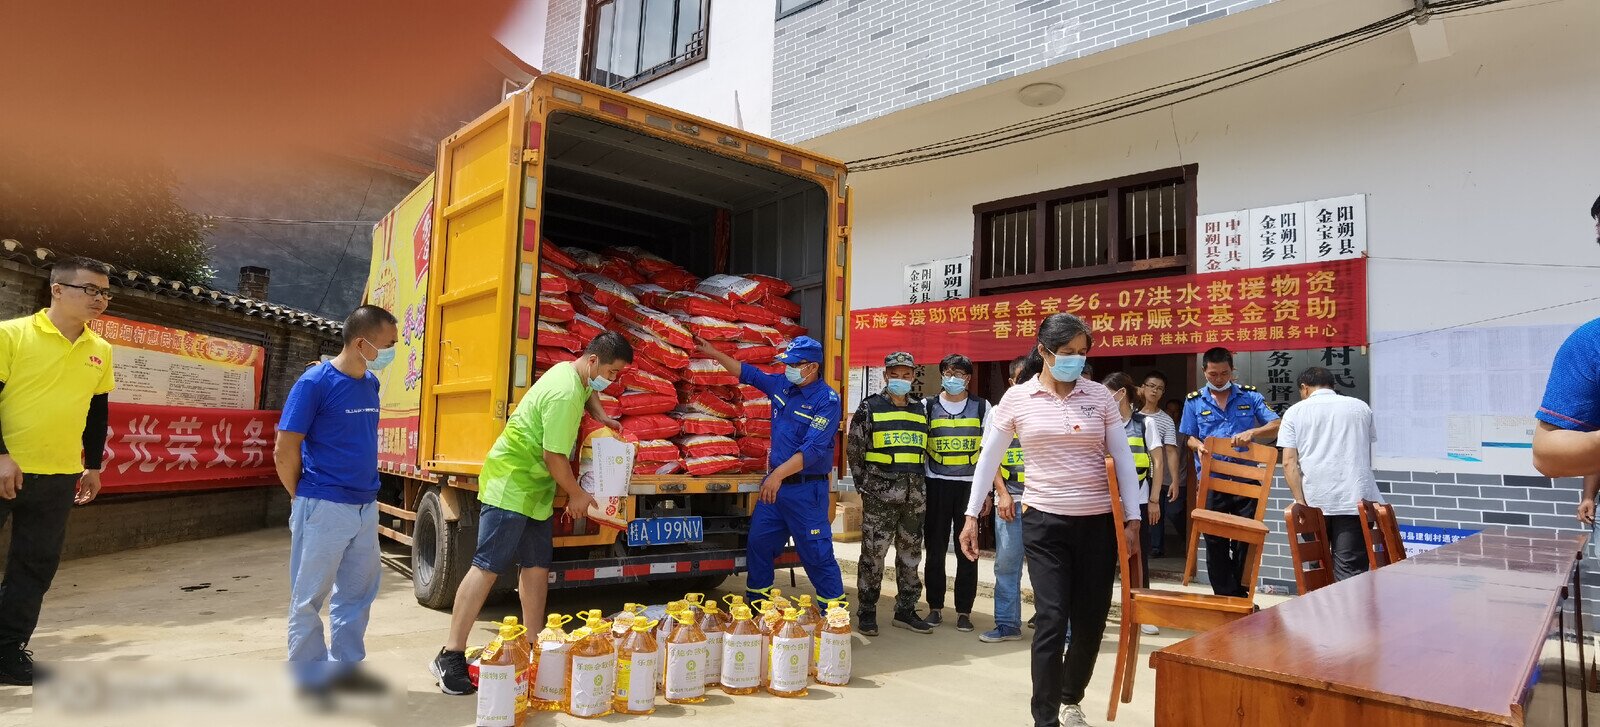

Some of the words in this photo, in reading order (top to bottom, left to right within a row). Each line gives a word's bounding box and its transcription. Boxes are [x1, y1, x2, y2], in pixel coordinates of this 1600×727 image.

[1225, 218, 1241, 270] 中国共
[1260, 215, 1276, 262] 金宝乡
[1280, 212, 1297, 260] 阳朔县
[1316, 208, 1333, 257] 金宝乡
[1337, 206, 1354, 255] 阳朔县
[854, 270, 1336, 330] 乐施会援助阳朔县金宝乡6.07洪水救援物资
[1160, 323, 1337, 346] 桂林市蓝天救援服务中心
